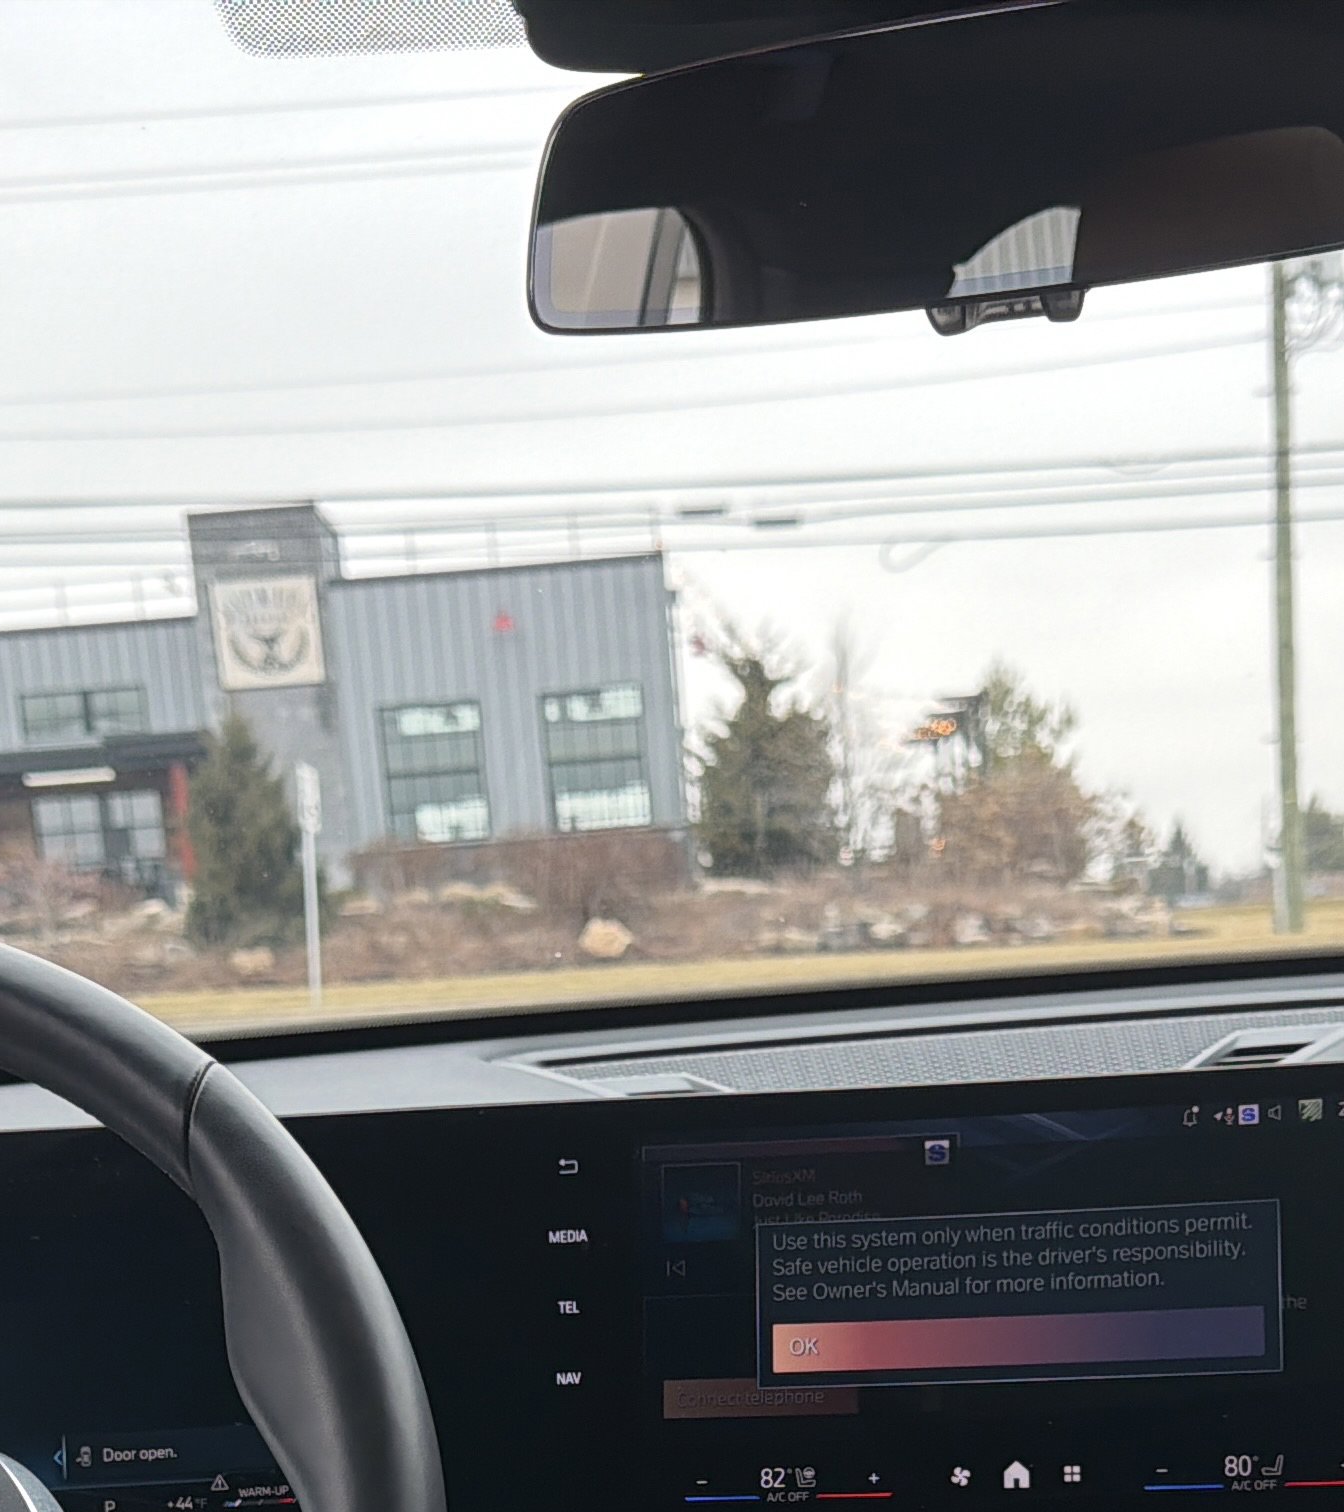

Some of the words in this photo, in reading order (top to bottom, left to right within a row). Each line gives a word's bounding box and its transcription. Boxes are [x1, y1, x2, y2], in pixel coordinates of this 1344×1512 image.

[753, 1191, 793, 1208] David
[797, 1191, 824, 1206] Lee
[828, 1190, 863, 1204] Roth
[548, 1229, 588, 1244] MEDIA
[773, 1233, 807, 1250] Use
[813, 1231, 846, 1249] this
[852, 1230, 917, 1251] system
[921, 1227, 960, 1247] only
[965, 1225, 1015, 1242] when
[1021, 1221, 1073, 1241] traffic
[1079, 1216, 1180, 1238] conditions
[1184, 1212, 1253, 1236] permit.
[773, 1257, 813, 1276] Safe
[818, 1255, 882, 1274] vehicle
[887, 1252, 976, 1275] operation
[982, 1251, 997, 1268] is
[1002, 1248, 1033, 1267] the
[1038, 1245, 1107, 1266] driver's
[1112, 1240, 1246, 1264] responsibility.
[773, 1283, 807, 1301] See
[813, 1281, 887, 1300] Owner's
[892, 1278, 958, 1297] Manual
[965, 1277, 991, 1294] for
[996, 1275, 1044, 1292] more
[1050, 1271, 1165, 1290] information.
[558, 1301, 580, 1314] TEL
[789, 1337, 819, 1356] OK
[556, 1372, 581, 1385] NAV
[745, 1388, 825, 1406] telephone
[103, 1447, 137, 1463] Door
[139, 1447, 178, 1463] open.
[238, 1485, 290, 1498] WARM-UP
[1231, 1480, 1251, 1491] A/C
[1253, 1479, 1277, 1491] OFF
[767, 1491, 786, 1502] A/C
[787, 1491, 810, 1502] OFF
